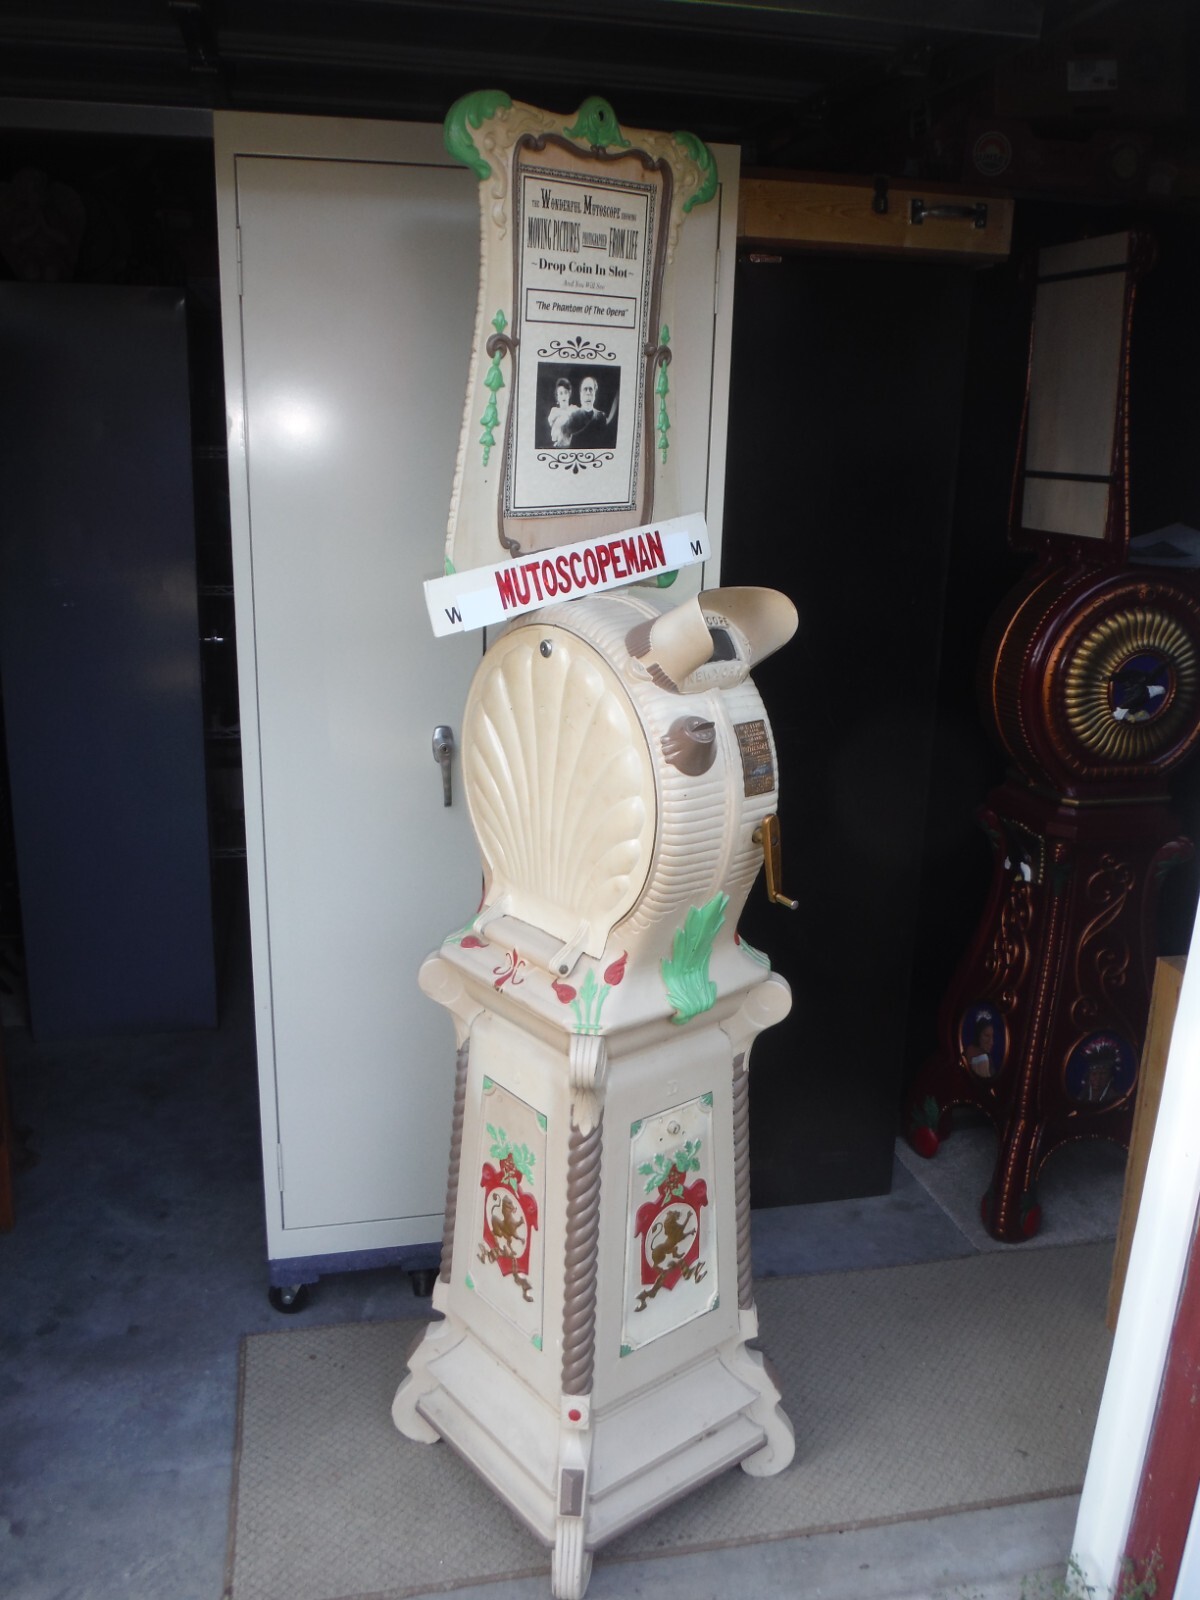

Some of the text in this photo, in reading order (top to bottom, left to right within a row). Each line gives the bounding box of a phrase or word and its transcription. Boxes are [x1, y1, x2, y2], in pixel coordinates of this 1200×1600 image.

[541, 188, 582, 214] WONDERFUL
[583, 195, 621, 219] MUTOSCOPE
[527, 217, 552, 250] MOVING
[552, 220, 581, 253] PICTURES
[608, 227, 625, 259] FROM
[625, 230, 639, 260] LIFE
[568, 261, 593, 275] Coin
[595, 263, 606, 276] In
[552, 302, 583, 313] Phantom
[584, 305, 592, 315] Of
[593, 306, 605, 315] The
[494, 529, 667, 610] MUTOSCOPEMAN
